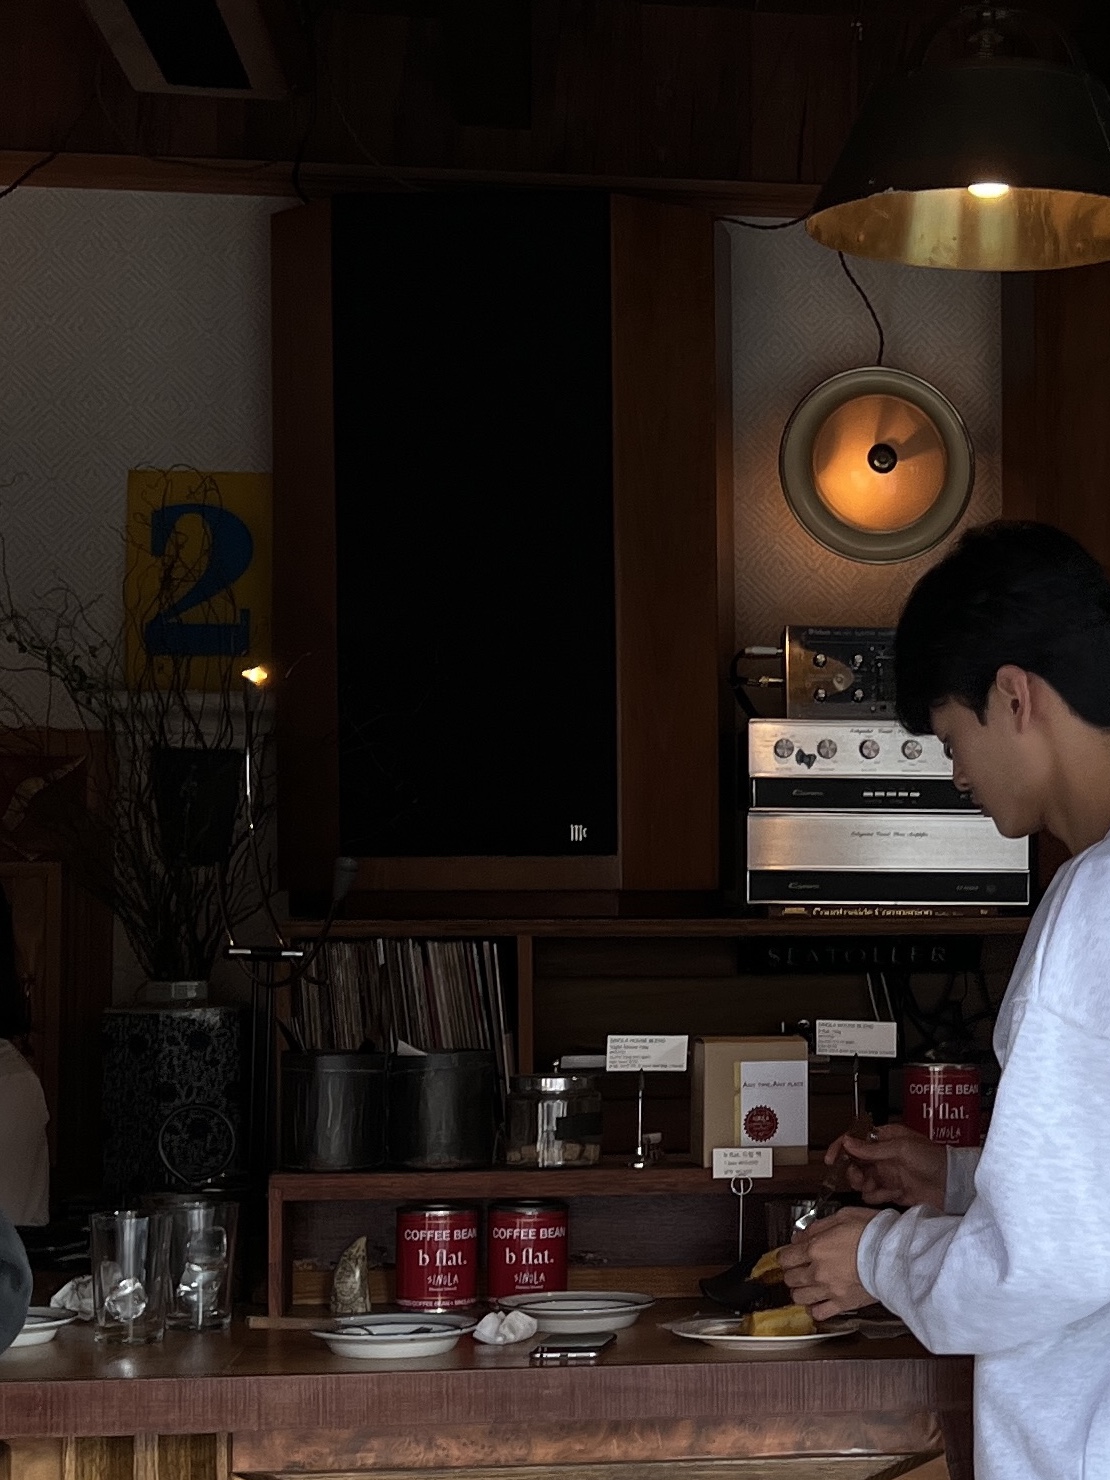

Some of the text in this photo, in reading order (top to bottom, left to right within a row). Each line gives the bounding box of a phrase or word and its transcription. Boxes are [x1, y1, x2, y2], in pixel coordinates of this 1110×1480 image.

[145, 503, 252, 657] 2
[909, 1083, 979, 1095] COFFEE BEAN
[939, 1103, 969, 1119] flat.
[404, 1228, 477, 1241] COFFEE BEAN
[492, 1226, 566, 1240] COFFEE BEAN
[418, 1249, 467, 1266] b flat.
[505, 1247, 554, 1264] b flat.
